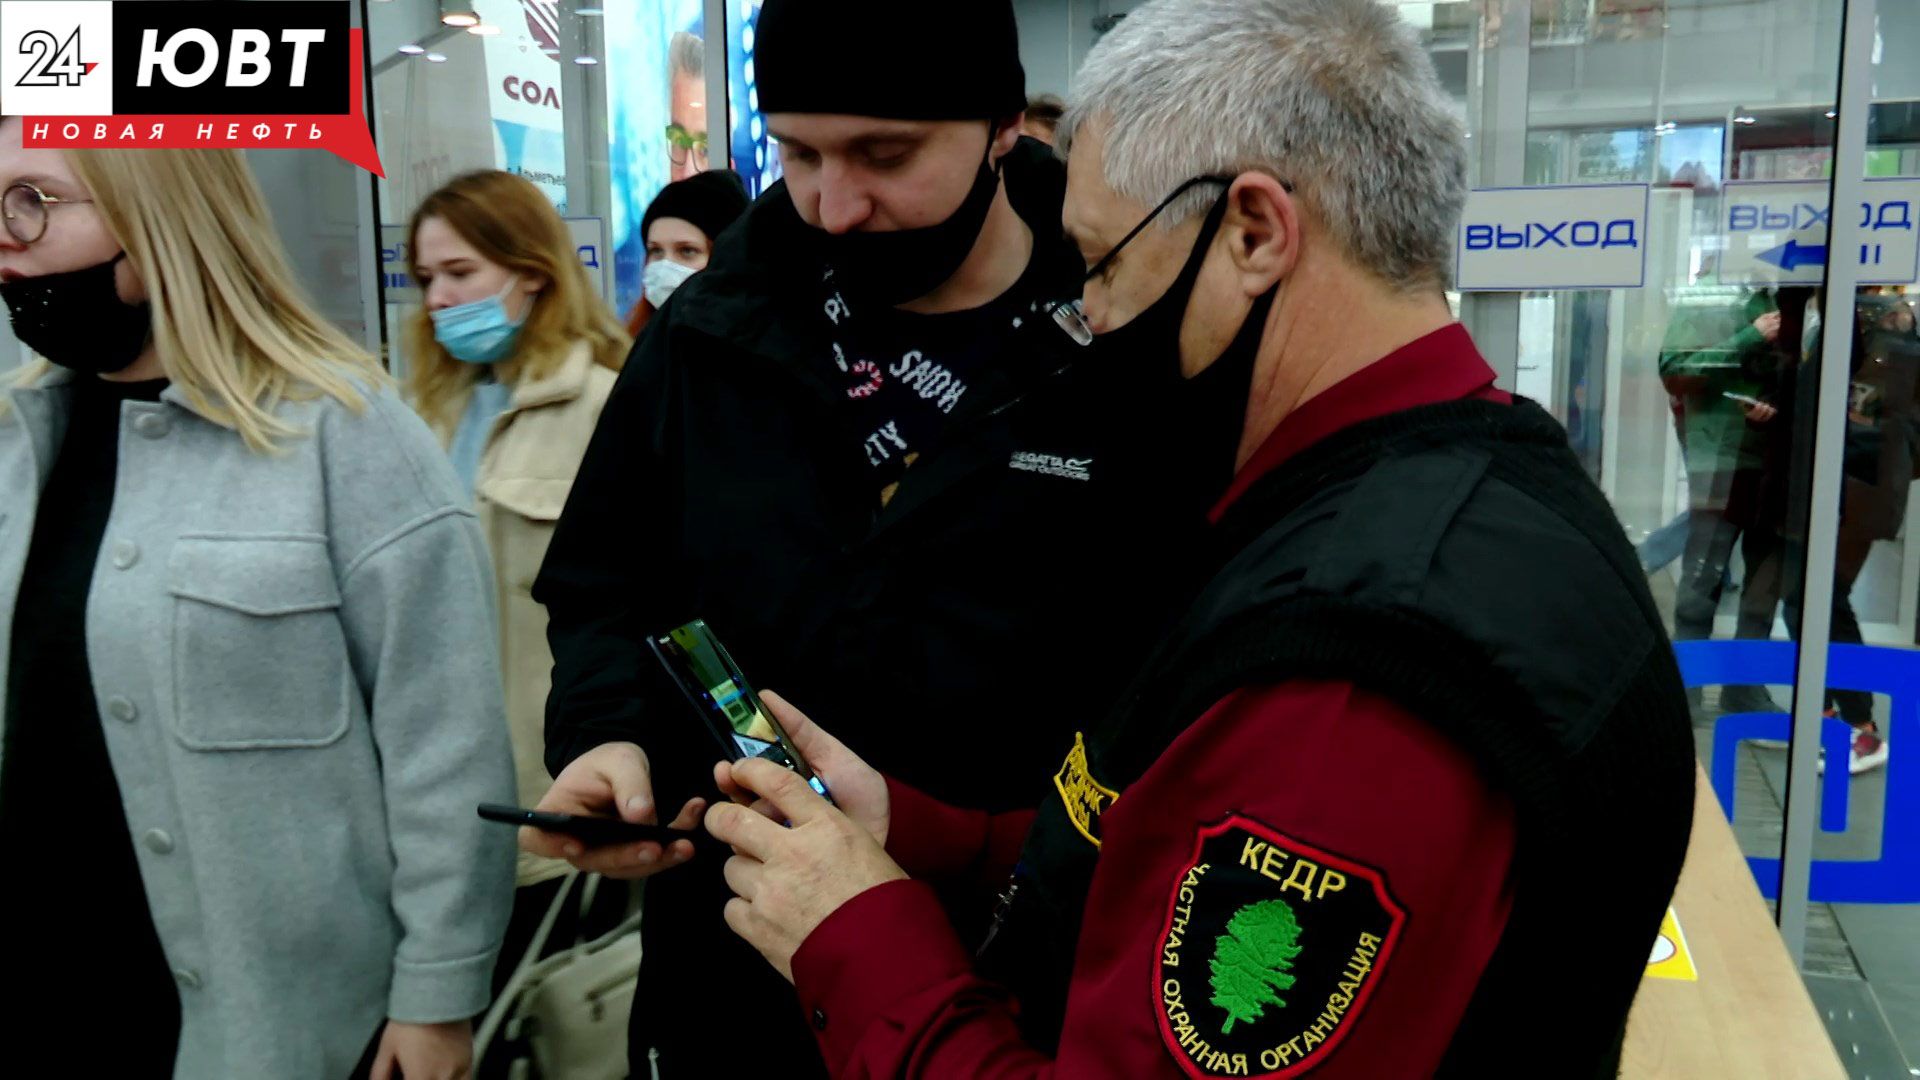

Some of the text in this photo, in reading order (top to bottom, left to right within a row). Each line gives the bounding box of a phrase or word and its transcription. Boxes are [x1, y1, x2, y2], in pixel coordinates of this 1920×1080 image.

[1465, 219, 1637, 250] ВЫХОД
[1239, 836, 1347, 902] КЕДР
[1162, 863, 1383, 1076] ЧАСТНАЯ ОХРАННАЯ ОРГАНИЗАЦИЯ
